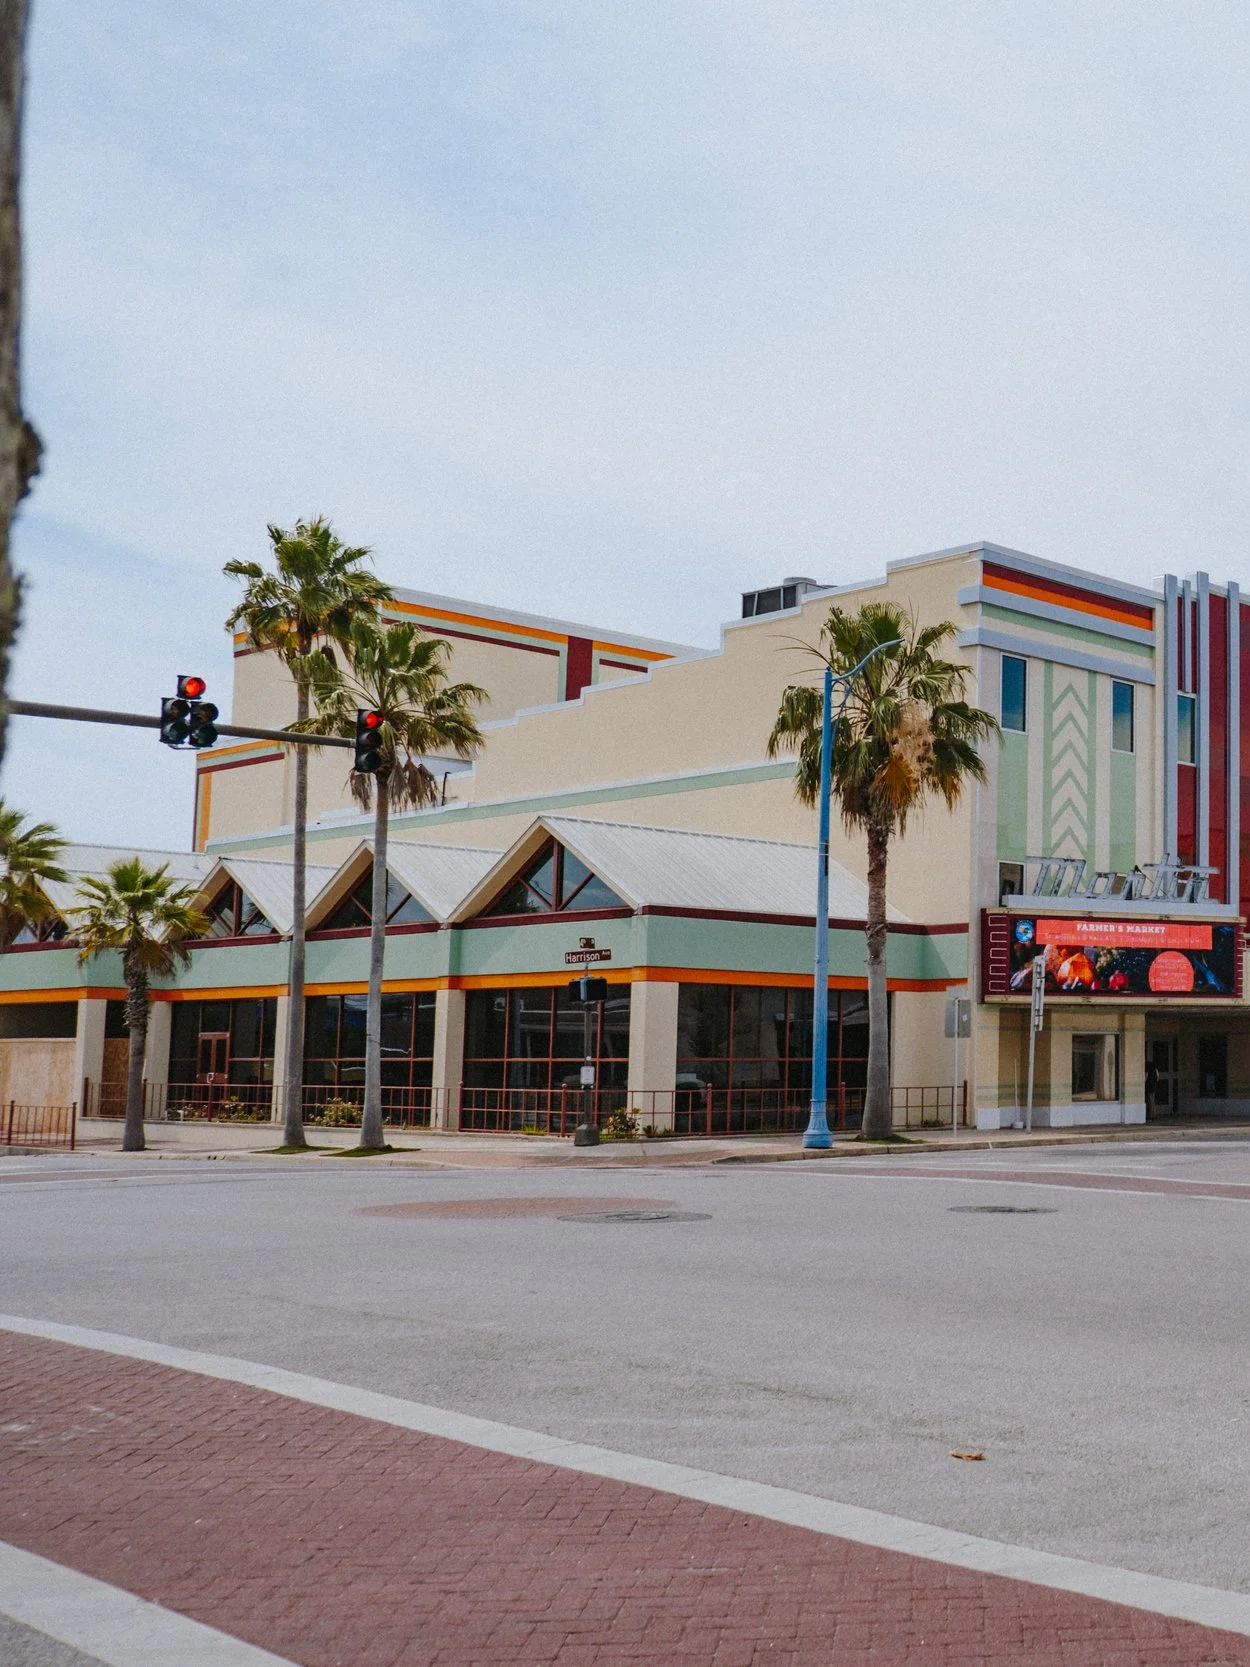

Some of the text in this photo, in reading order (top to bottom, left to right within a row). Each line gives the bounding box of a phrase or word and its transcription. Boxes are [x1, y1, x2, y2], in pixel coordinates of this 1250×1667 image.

[1076, 923, 1166, 934] FARMER'S MARKET
[565, 951, 600, 963] Harrison
